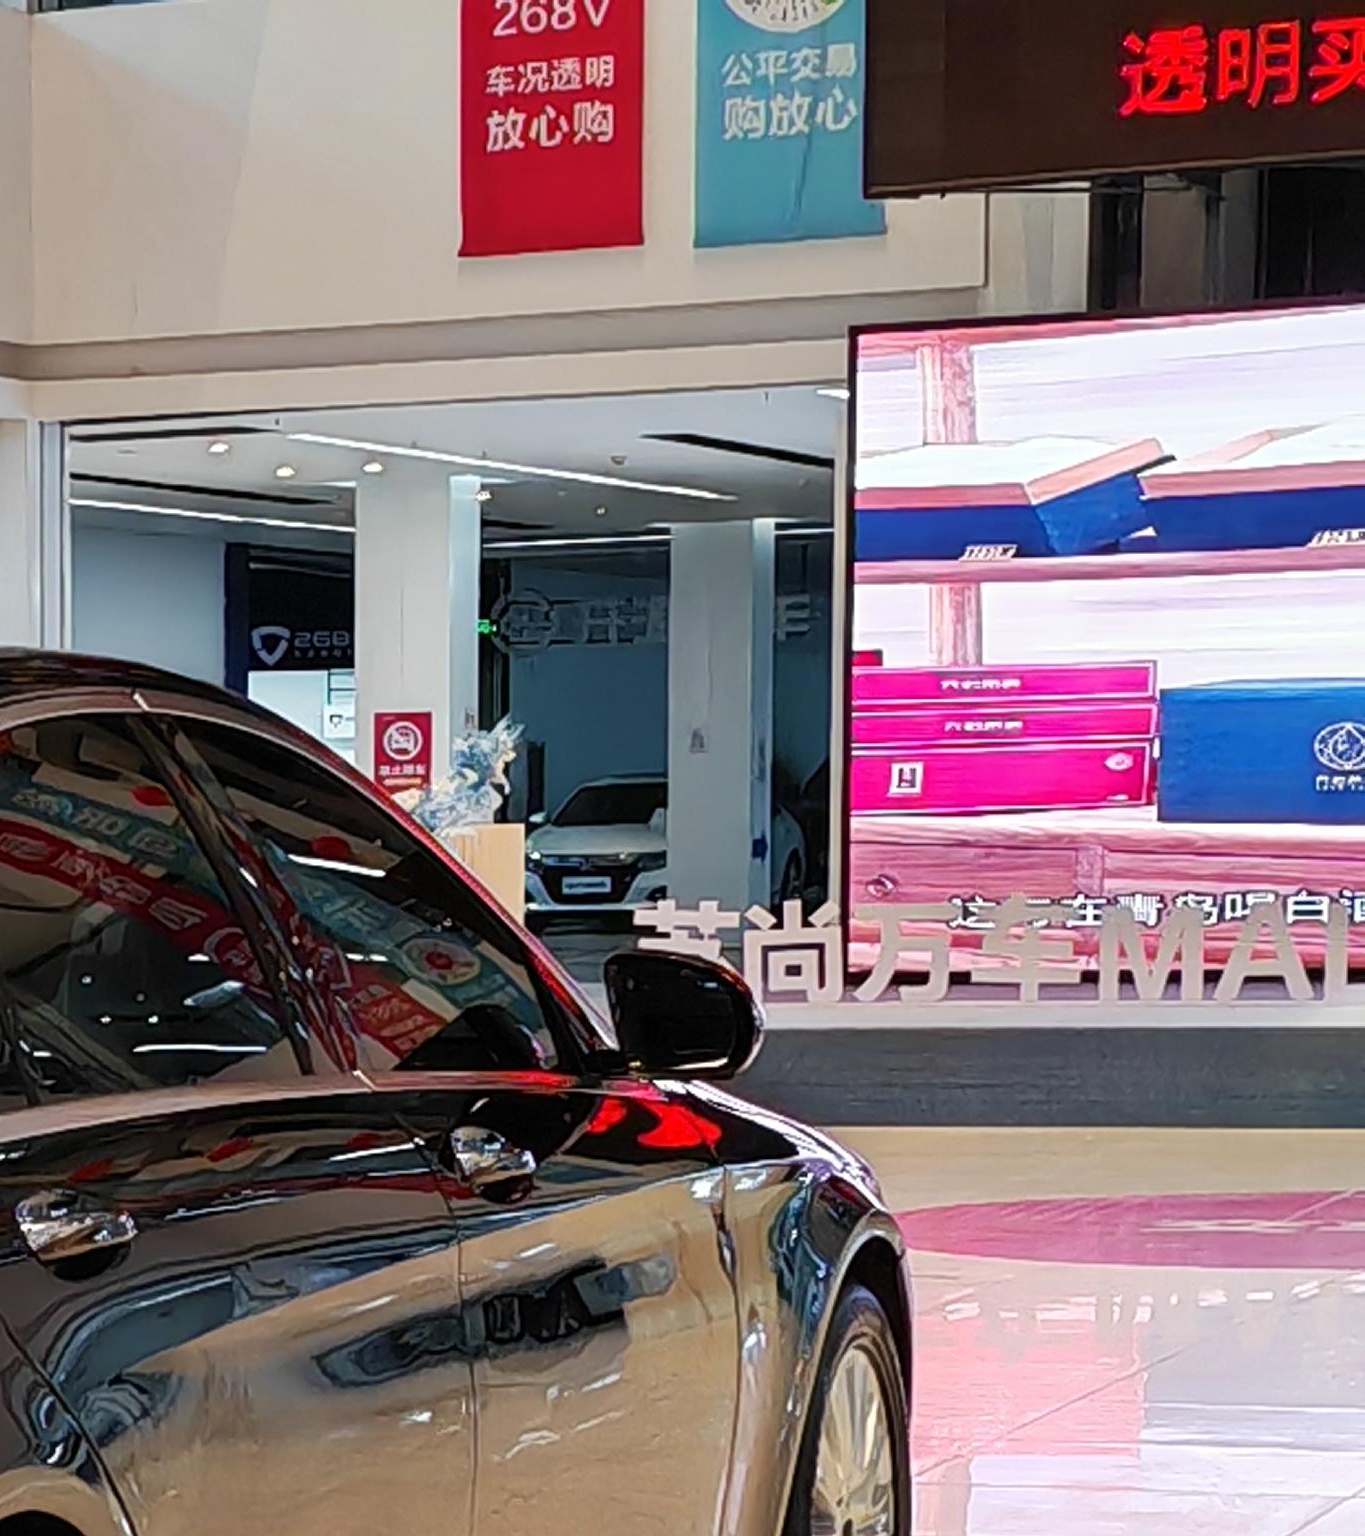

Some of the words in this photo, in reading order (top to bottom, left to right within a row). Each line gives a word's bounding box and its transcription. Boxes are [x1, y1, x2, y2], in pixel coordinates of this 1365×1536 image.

[493, 0, 610, 38] 268V
[485, 55, 615, 97] 车况透明
[721, 42, 858, 88] 公平交易
[1118, 16, 1365, 119] 透明买
[485, 99, 615, 154] 放心购
[722, 83, 860, 141] 购放心
